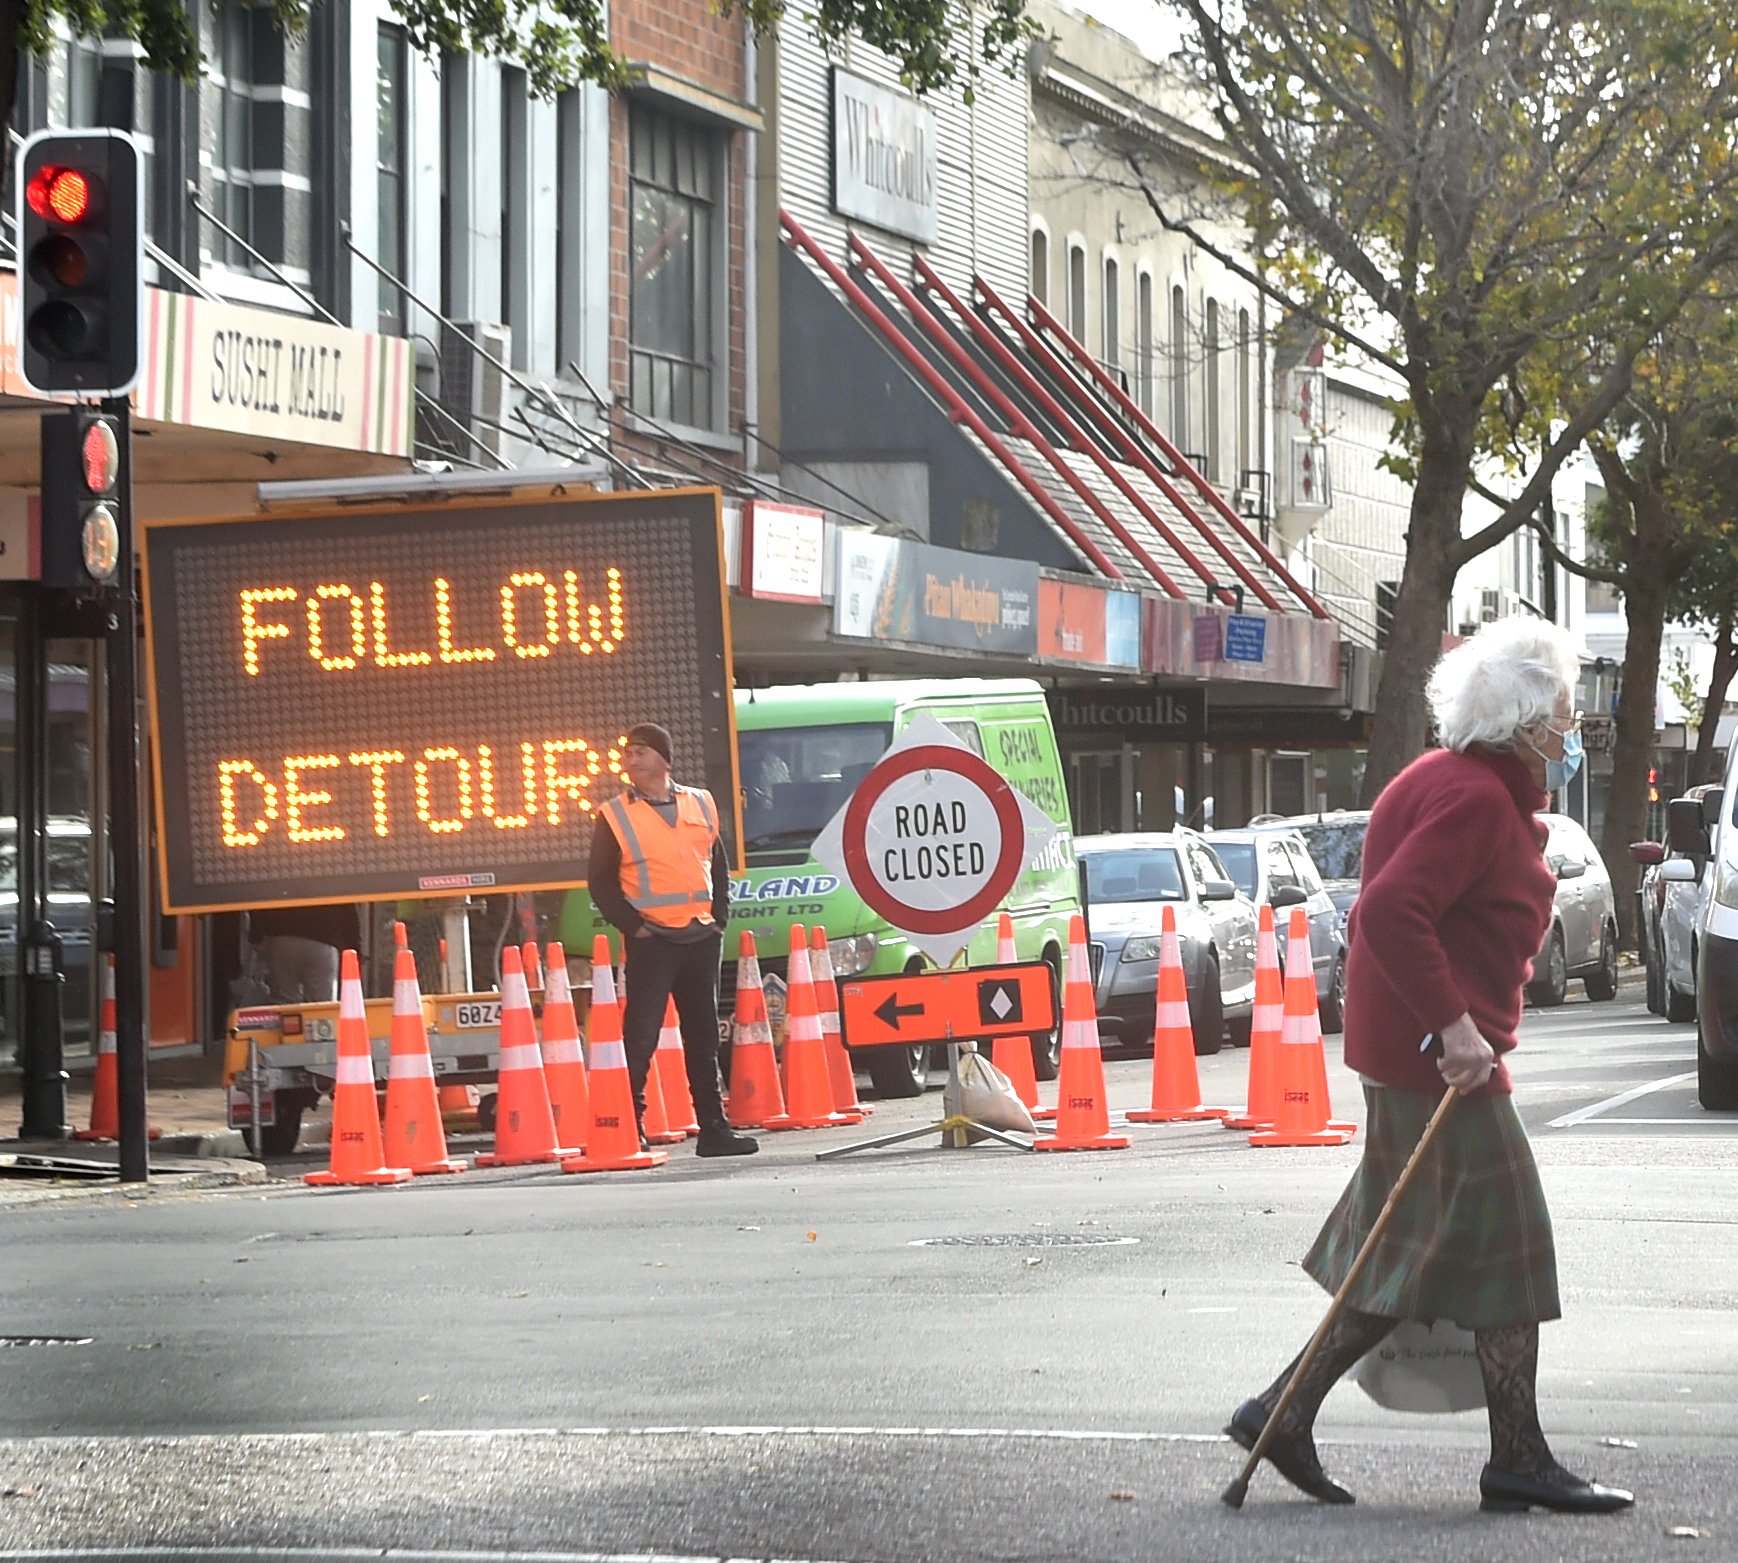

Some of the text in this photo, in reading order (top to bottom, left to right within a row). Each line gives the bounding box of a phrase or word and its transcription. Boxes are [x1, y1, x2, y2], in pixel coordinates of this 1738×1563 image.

[210, 330, 345, 423] SUSHI MALL
[239, 566, 626, 677] FOLLOW
[1056, 695, 1188, 726] hitcoulls
[895, 801, 966, 839] ROAD
[884, 842, 985, 882] CLOSED
[787, 904, 825, 916] LTD
